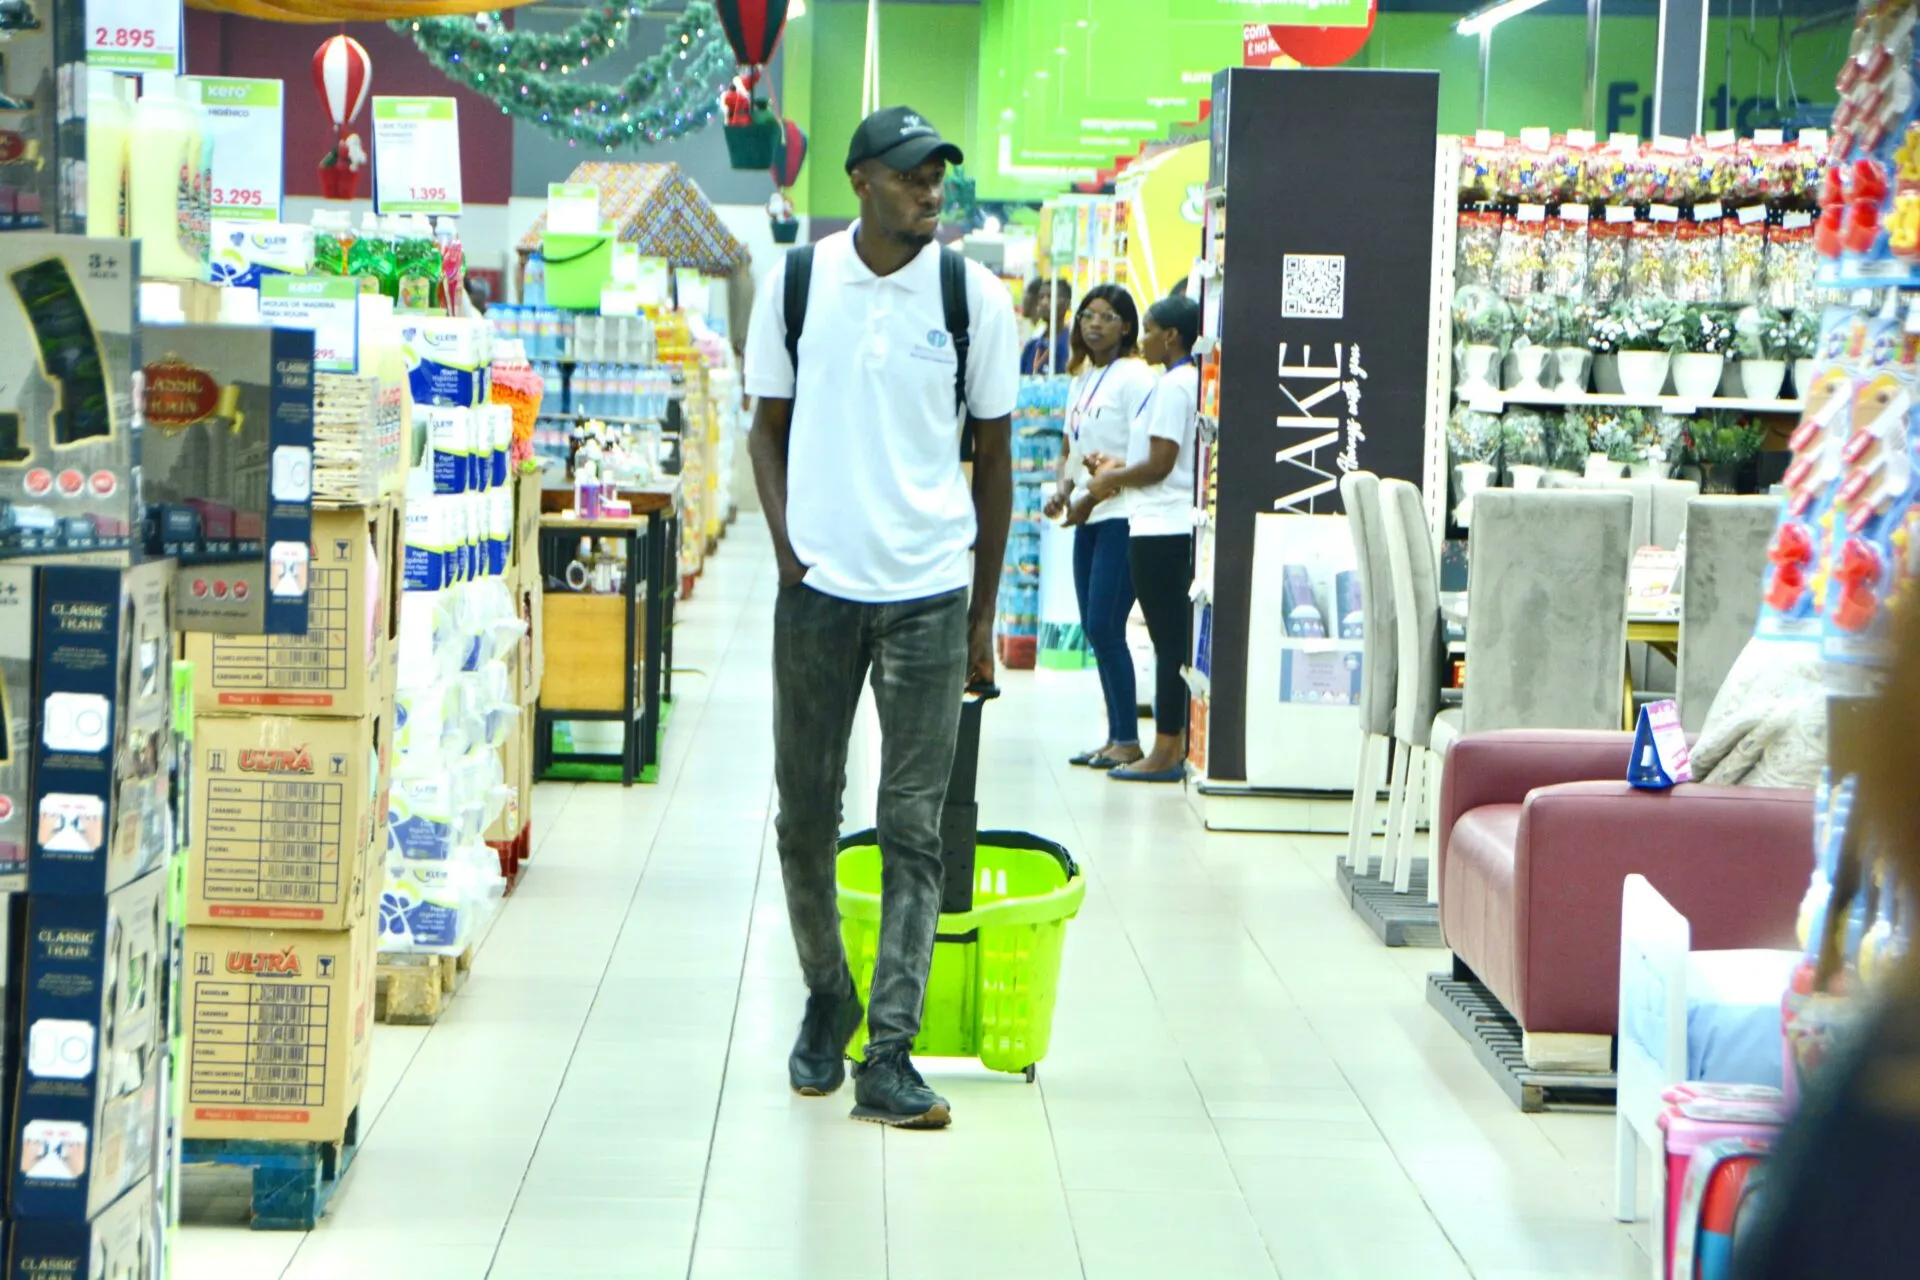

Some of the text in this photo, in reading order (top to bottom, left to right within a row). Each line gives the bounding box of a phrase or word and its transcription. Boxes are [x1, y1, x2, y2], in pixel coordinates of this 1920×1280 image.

[95, 27, 155, 48] 2.895
[212, 188, 262, 206] 3.295
[409, 187, 446, 200] 1.395
[51, 603, 108, 617] CLASSIC
[61, 617, 104, 630] TRAIN
[238, 745, 315, 774] ULTRA
[38, 928, 96, 944] CLASSIC
[47, 943, 90, 957] TRAIN
[226, 947, 302, 975] ULTRA
[20, 1256, 79, 1271] CLASSIC
